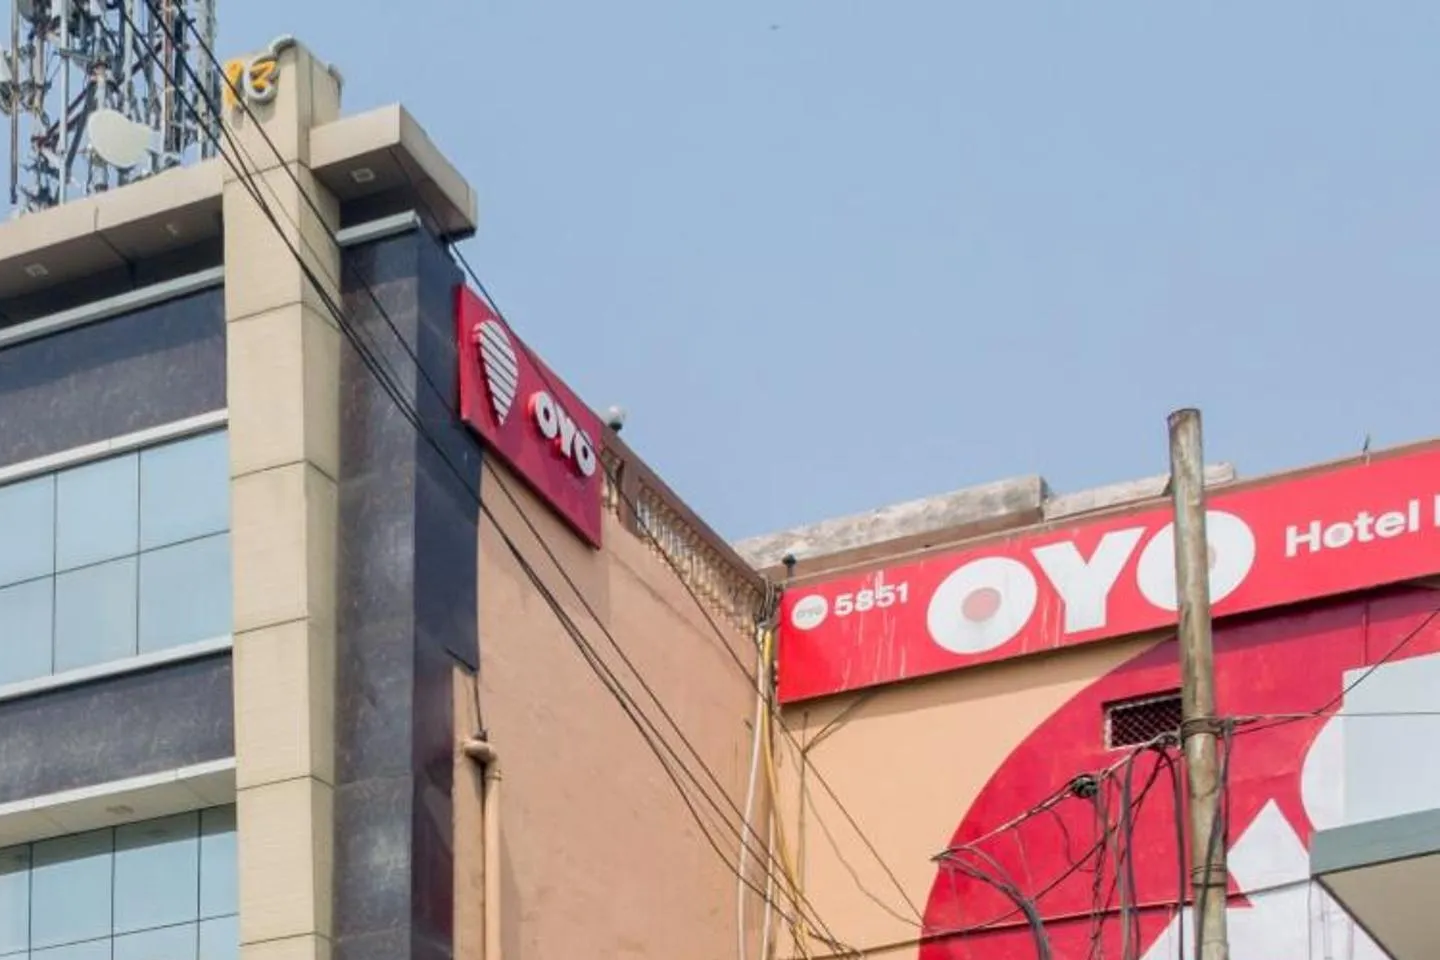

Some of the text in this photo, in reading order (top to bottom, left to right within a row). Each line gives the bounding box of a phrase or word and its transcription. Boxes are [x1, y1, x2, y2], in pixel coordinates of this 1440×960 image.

[529, 390, 597, 477] OYO
[1284, 497, 1420, 558] Hotel
[833, 580, 909, 617] 5851
[927, 510, 1256, 655] OYO
